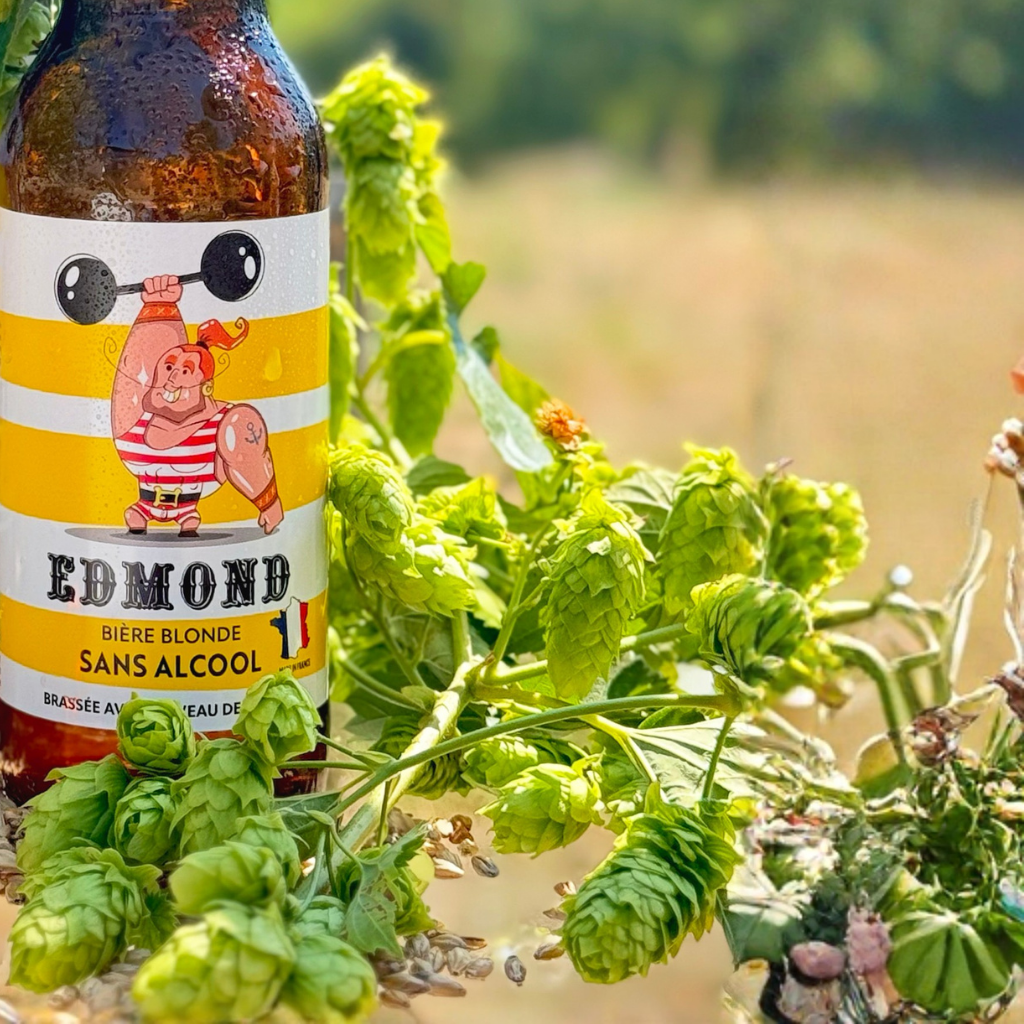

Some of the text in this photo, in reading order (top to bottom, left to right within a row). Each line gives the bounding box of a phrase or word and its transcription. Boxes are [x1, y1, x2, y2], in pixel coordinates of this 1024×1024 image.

[47, 552, 291, 611] EDMOND
[101, 622, 241, 644] BIÈRE BLONDE
[79, 649, 261, 678] SANS ALCOOL
[43, 691, 100, 714] BRASSÉE
[182, 704, 218, 718] 'EAU
[222, 702, 241, 716] DE
